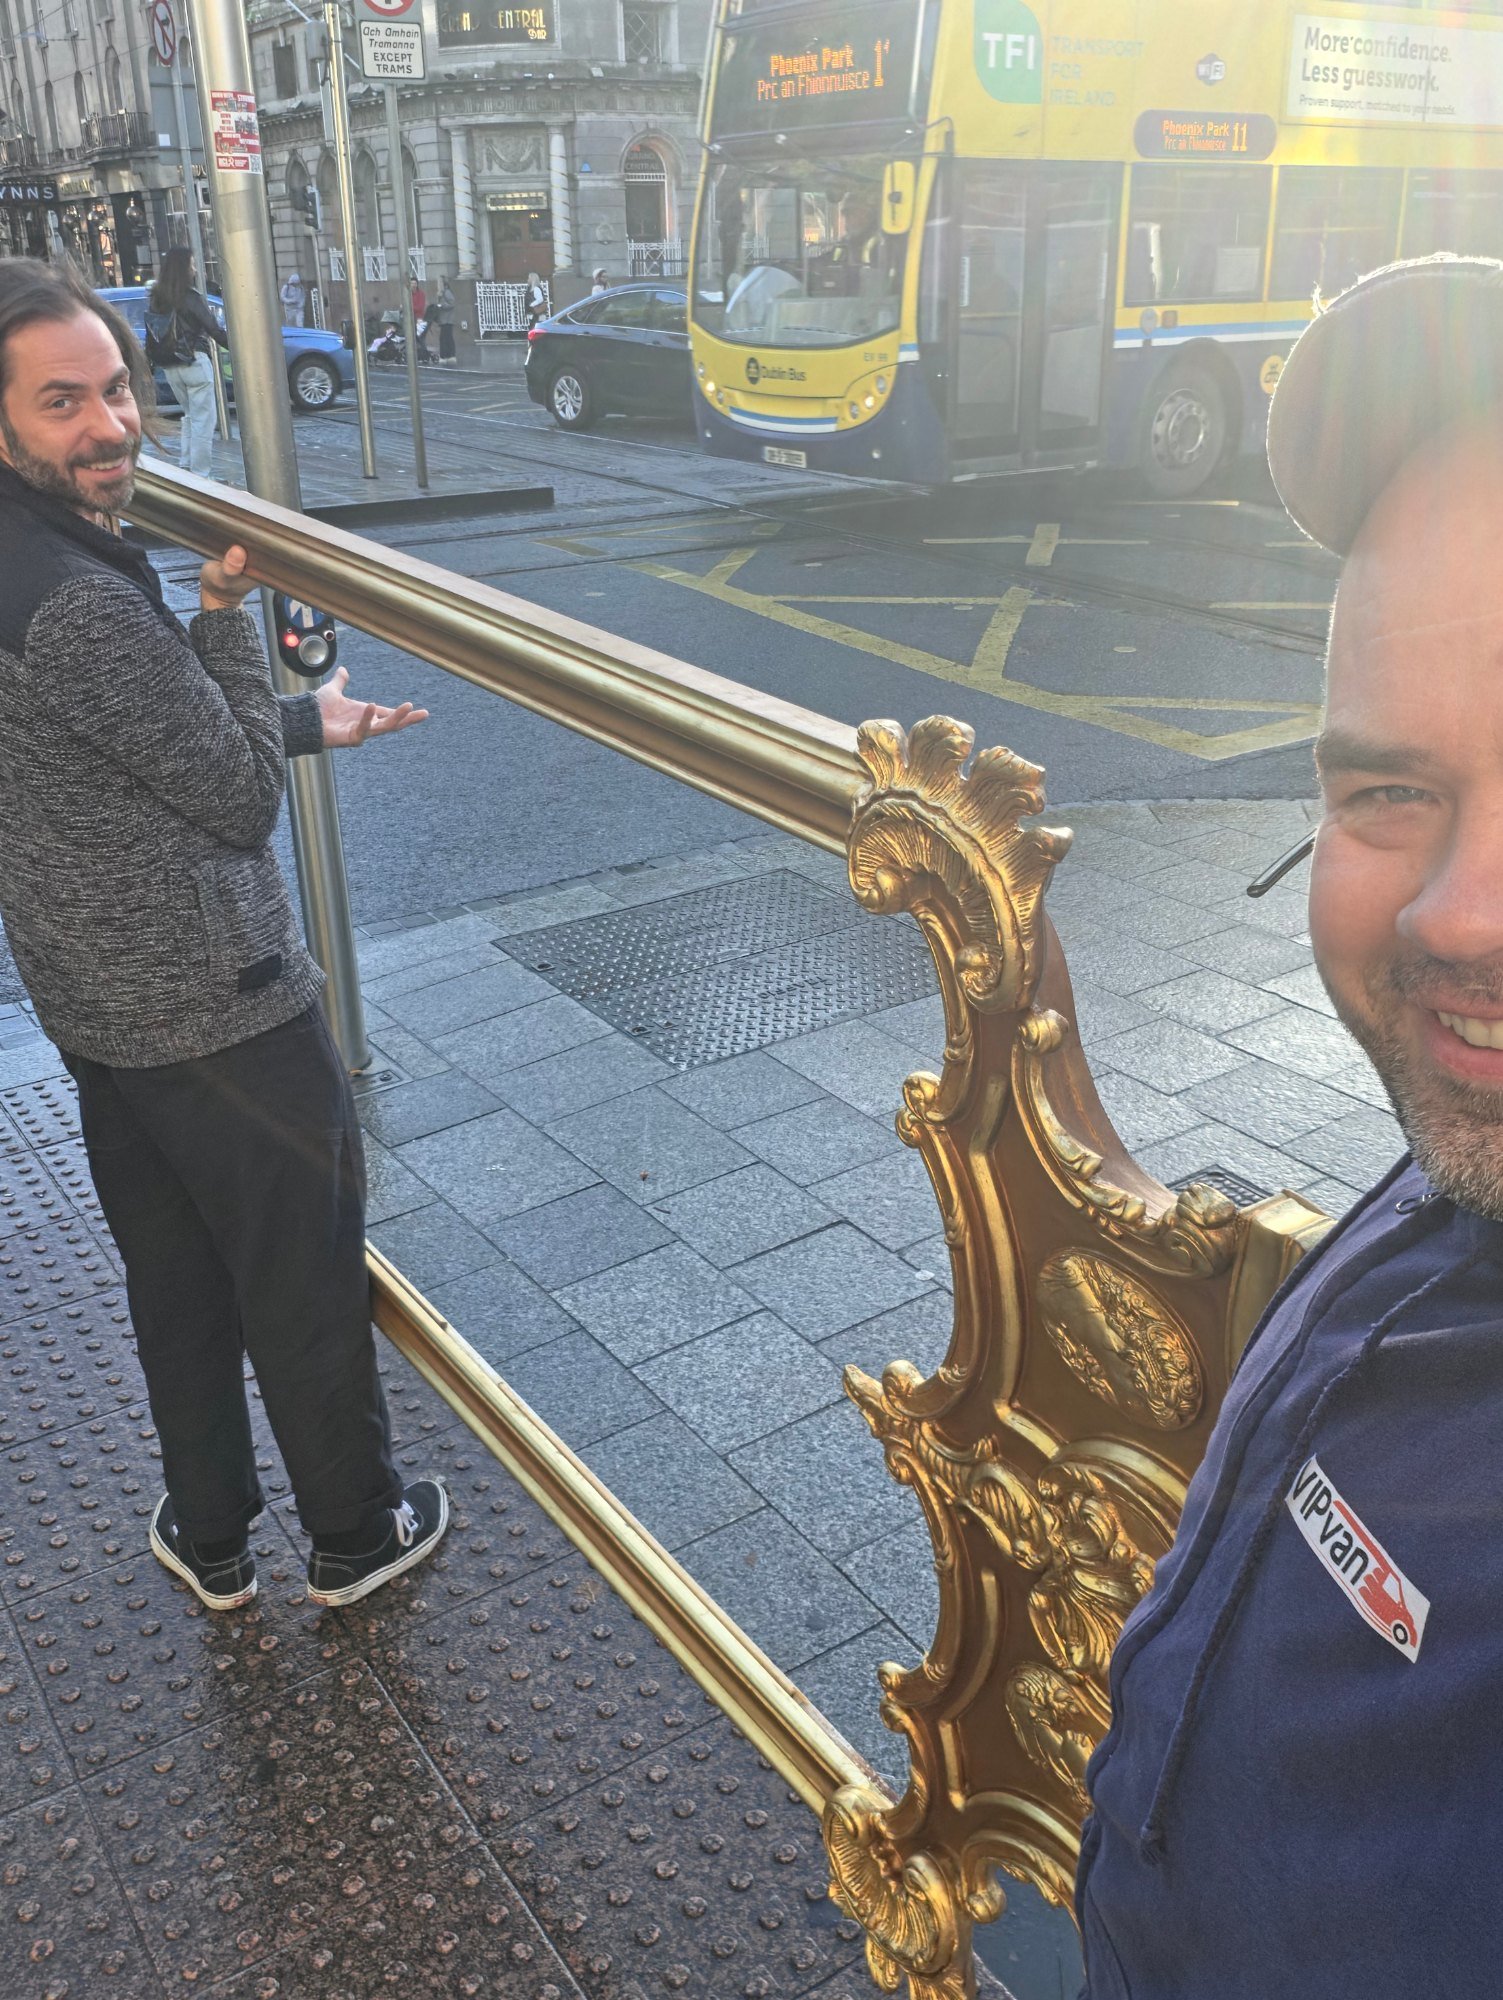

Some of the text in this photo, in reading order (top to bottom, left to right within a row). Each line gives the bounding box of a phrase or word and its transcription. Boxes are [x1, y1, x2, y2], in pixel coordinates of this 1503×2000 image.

[363, 26, 381, 37] Ach
[369, 38, 415, 49] Tramanna
[982, 32, 1036, 70] TFI
[1051, 36, 1145, 57] TRANSPORT
[1304, 26, 1453, 63] More confidence.
[373, 52, 412, 62] EXCEPT
[770, 54, 818, 77] Phoenix
[822, 44, 854, 70] Park
[376, 64, 412, 74] TRAMS
[1051, 63, 1081, 79] FOR
[1301, 58, 1440, 92] Less guesswork.
[757, 79, 778, 101] Prc
[781, 80, 795, 98] an
[1050, 89, 1116, 106] IRELAND
[1163, 120, 1248, 152] Phoenix Park 11
[788, 367, 807, 382] Bus
